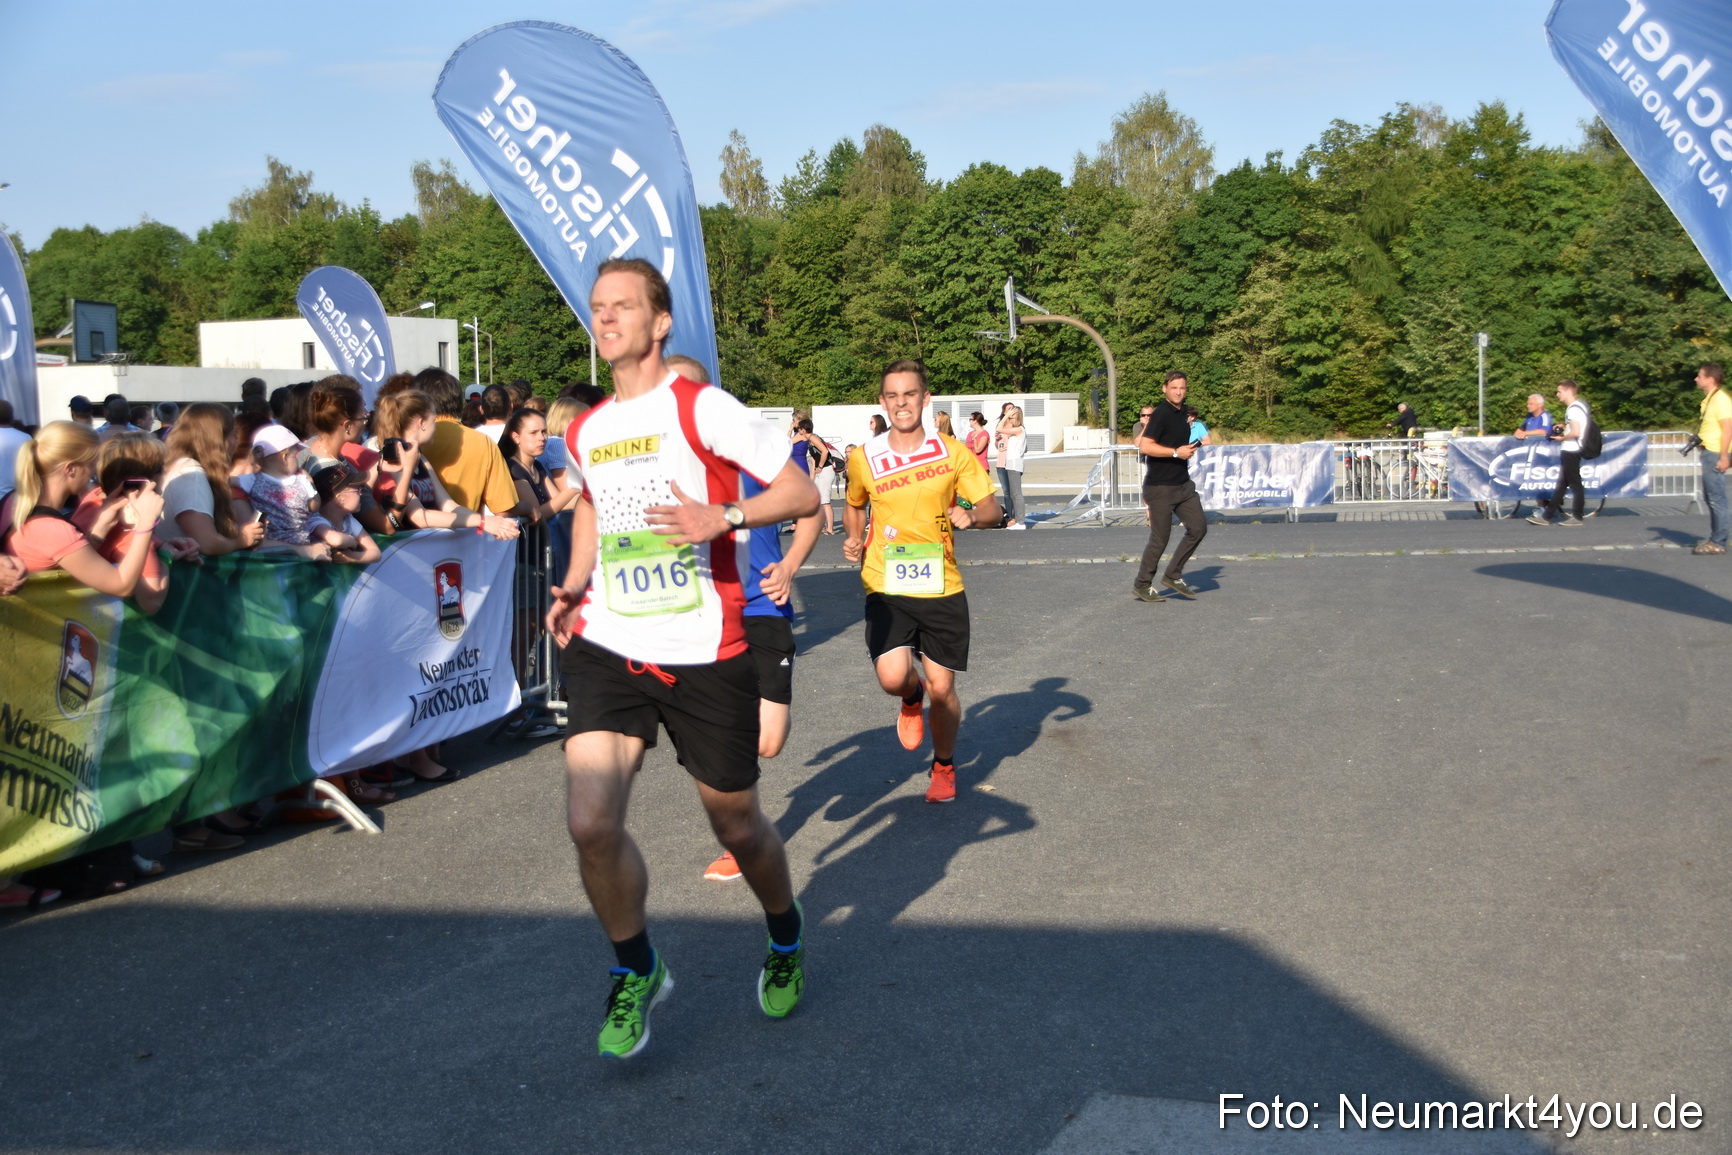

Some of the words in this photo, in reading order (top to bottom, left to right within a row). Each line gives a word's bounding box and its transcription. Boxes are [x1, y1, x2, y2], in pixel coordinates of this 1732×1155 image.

[592, 438, 653, 463] ONLINE
[624, 454, 660, 467] Germany
[875, 475, 911, 495] MAX
[915, 463, 954, 482] BÖGL
[1204, 470, 1296, 490] Fischer
[1509, 462, 1602, 481] Fiscer
[615, 560, 689, 594] 1016
[895, 563, 932, 580] 934
[444, 621, 461, 634] 1628
